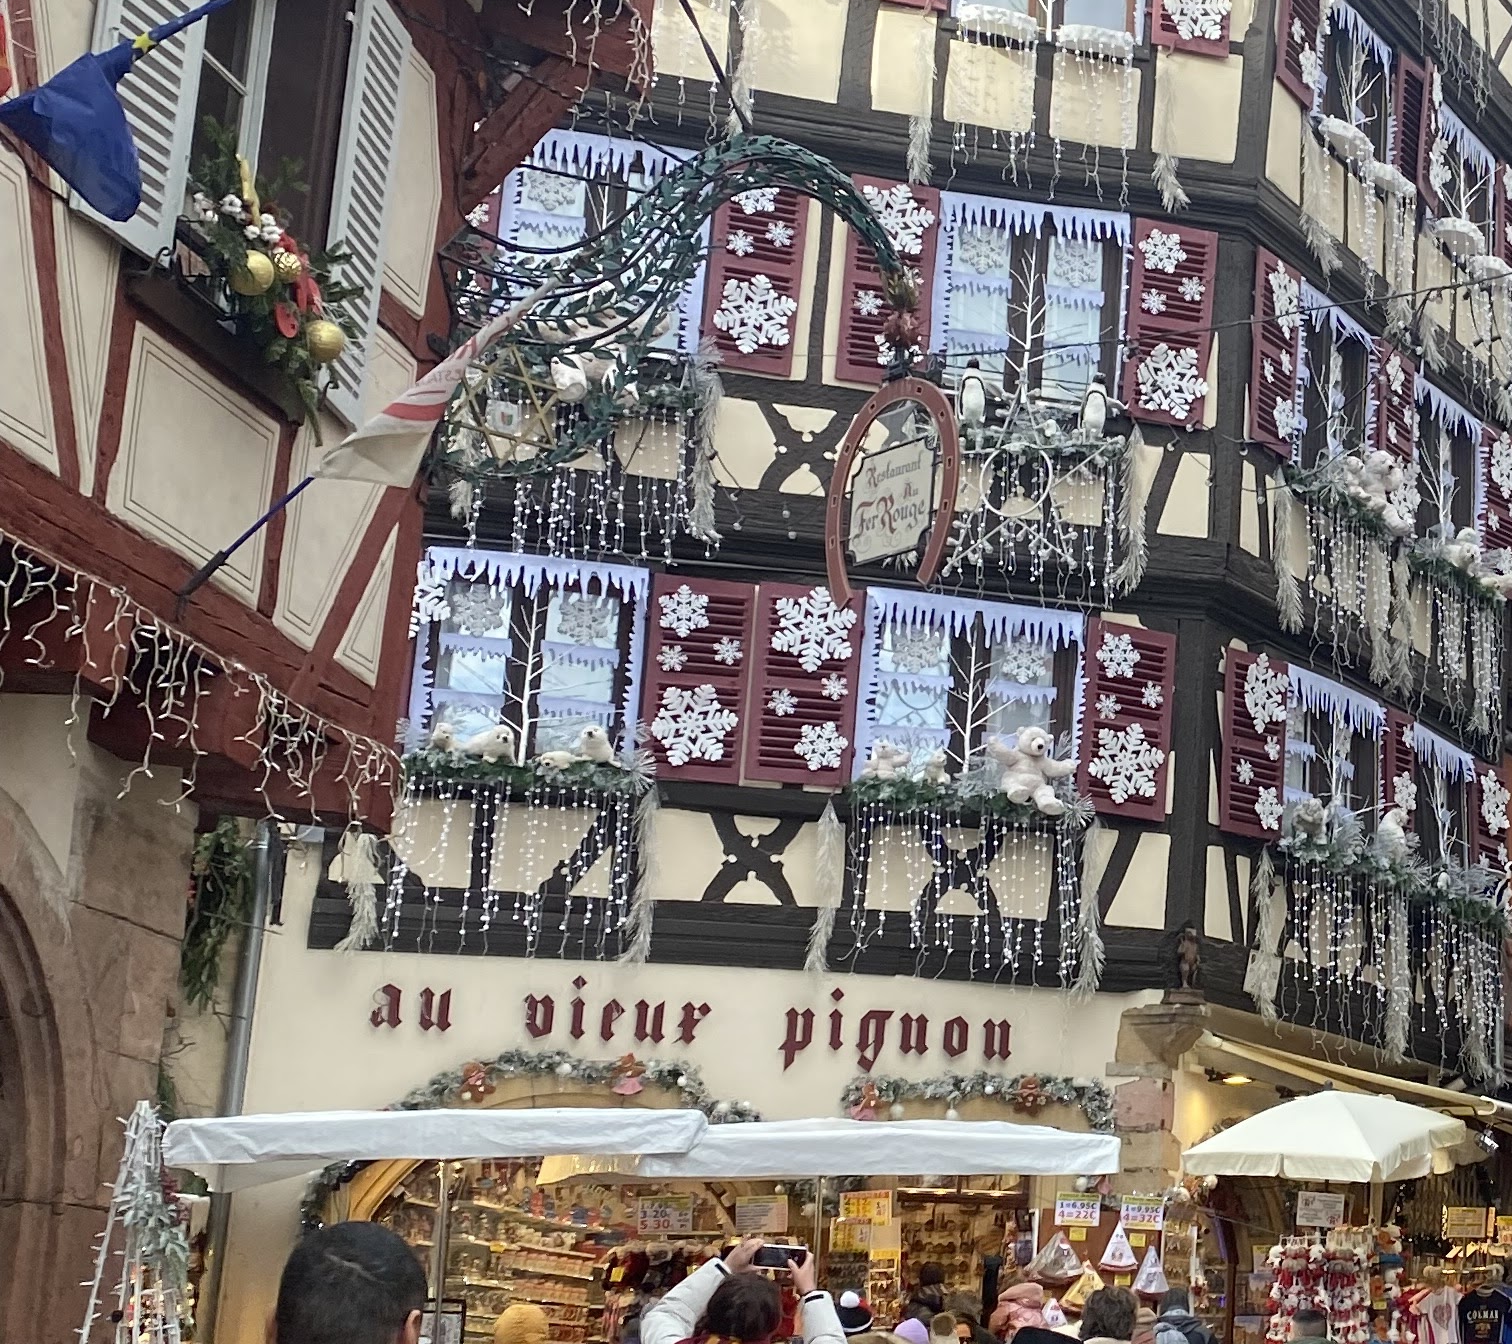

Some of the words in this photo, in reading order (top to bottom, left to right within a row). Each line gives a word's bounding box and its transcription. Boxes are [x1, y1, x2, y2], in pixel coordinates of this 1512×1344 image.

[866, 450, 923, 487] Restaurant
[903, 482, 919, 499] Au
[876, 494, 925, 534] Rouge
[370, 983, 452, 1032] au
[524, 975, 712, 1044] vieux
[778, 987, 1012, 1072] pignon
